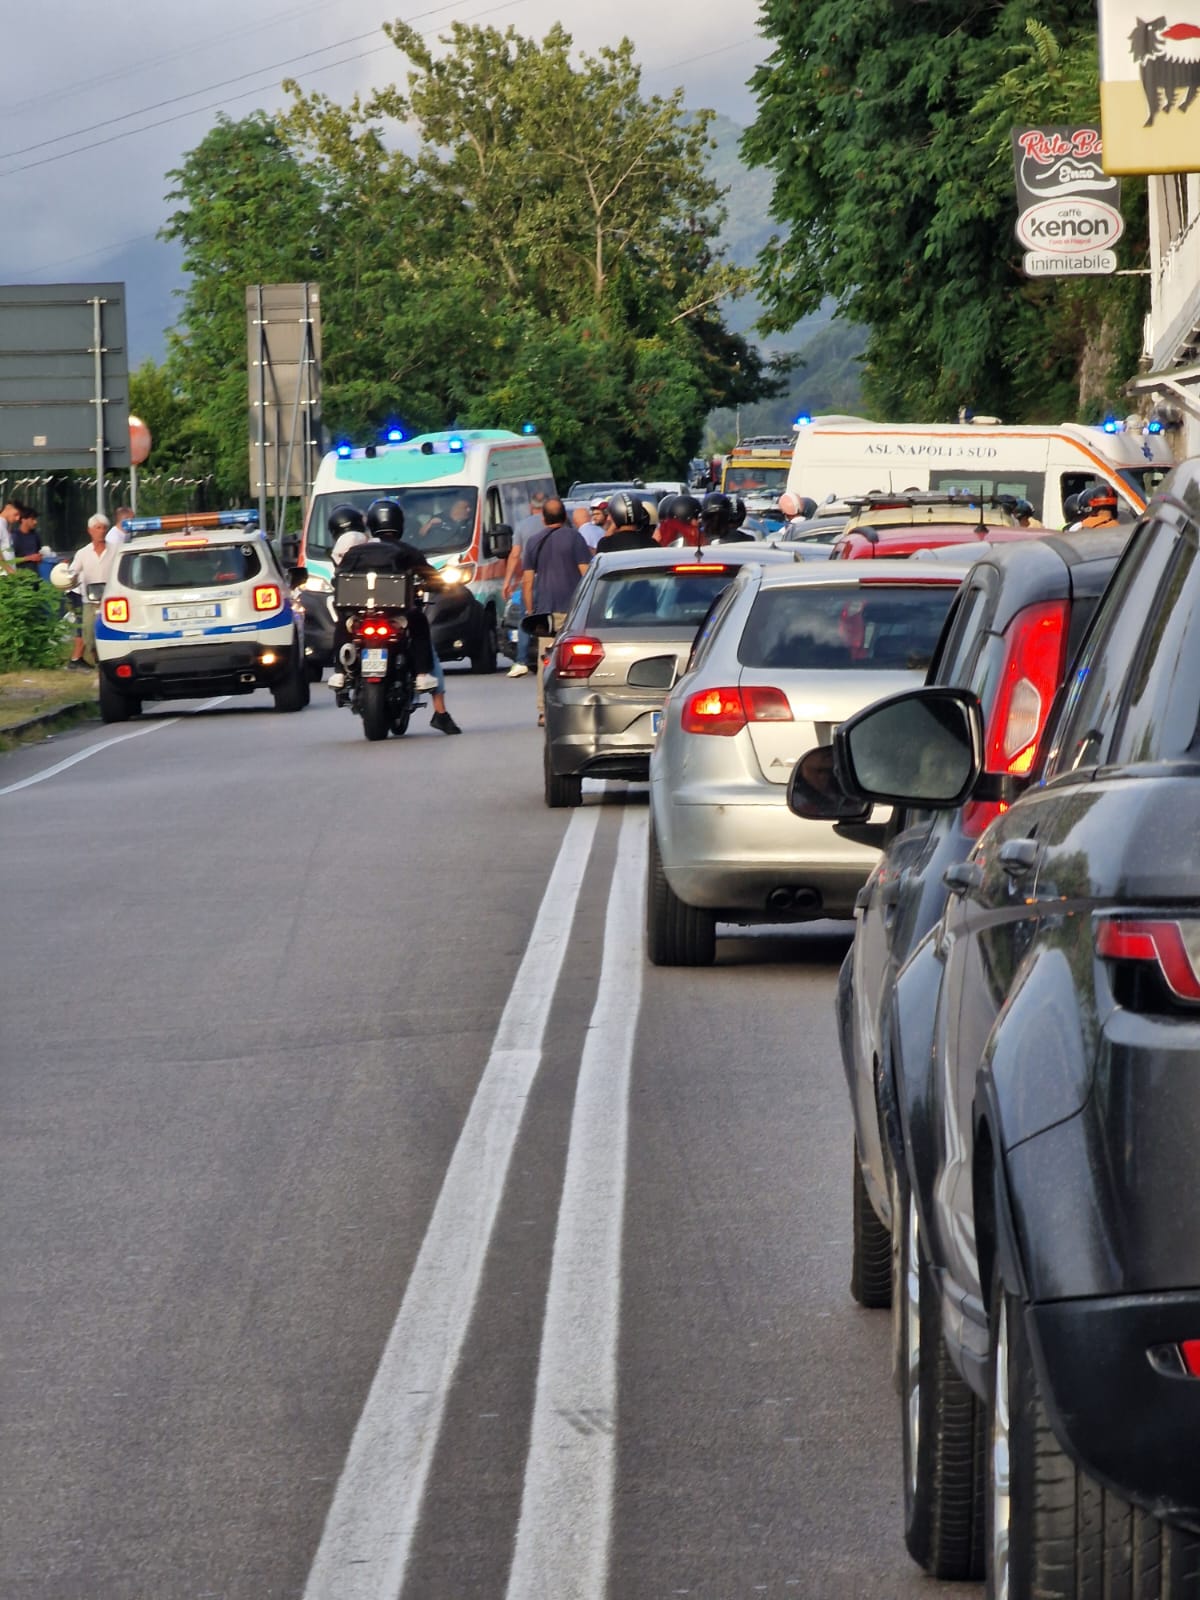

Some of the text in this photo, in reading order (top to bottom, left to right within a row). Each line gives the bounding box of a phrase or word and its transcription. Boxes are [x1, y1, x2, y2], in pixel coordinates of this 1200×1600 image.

[1018, 130, 1071, 164] Risto
[1031, 218, 1109, 237] kenon
[1031, 254, 1111, 271] inimitabile
[865, 444, 892, 455] ASL
[896, 444, 952, 457] NAPOLI
[968, 447, 998, 459] SUD
